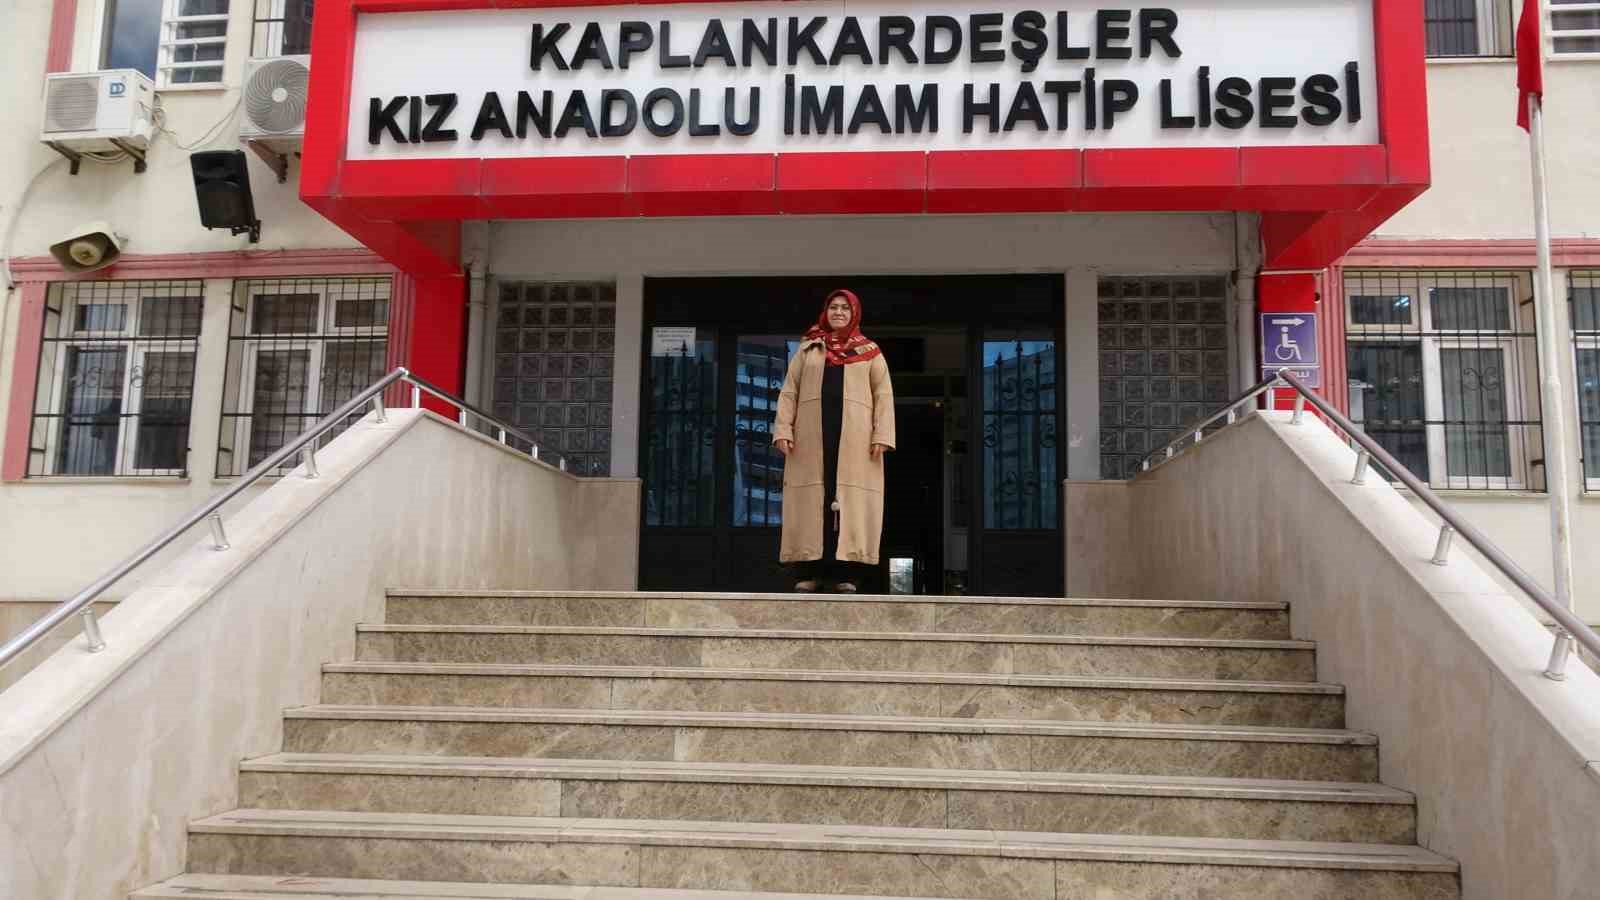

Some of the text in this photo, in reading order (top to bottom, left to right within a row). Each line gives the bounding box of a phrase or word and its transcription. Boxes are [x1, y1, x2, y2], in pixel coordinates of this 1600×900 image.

[529, 8, 1182, 74] KAPLANKARDEŞLER
[368, 62, 1362, 145] KIZ ANADOLU İMAM HATİP LİSESİ
